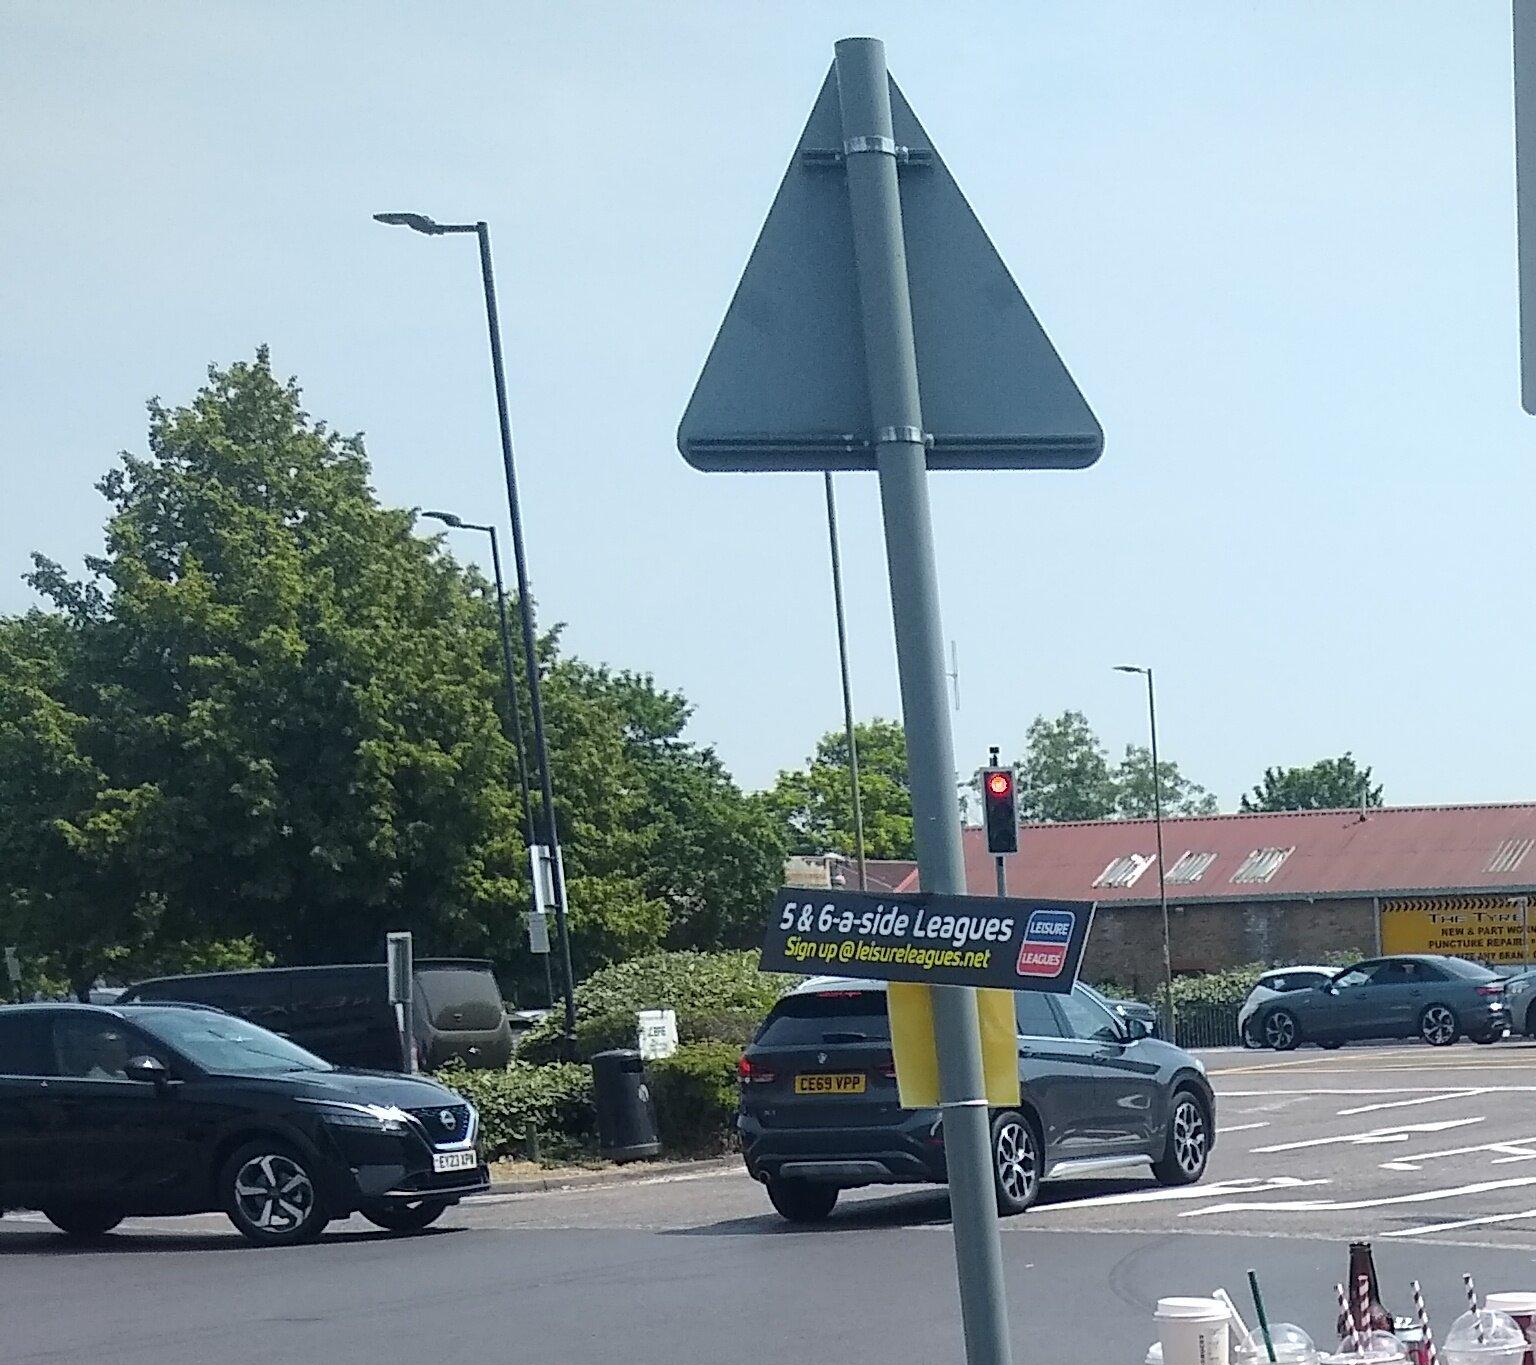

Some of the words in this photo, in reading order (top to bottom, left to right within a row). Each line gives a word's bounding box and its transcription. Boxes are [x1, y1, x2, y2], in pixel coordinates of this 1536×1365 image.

[780, 903, 798, 930] 5
[798, 904, 813, 931] &
[818, 904, 909, 937] 6-a-side
[913, 909, 1014, 947] Leagues
[1029, 920, 1069, 937] LEISURE
[1441, 928, 1464, 936] NEW
[1478, 926, 1504, 935] PART
[784, 936, 816, 960] Sign
[819, 942, 836, 963] up
[1428, 939, 1484, 949] PUNCTURE
[1486, 938, 1526, 947] REPAIR
[1021, 952, 1064, 967] LEAGUES
[1500, 951, 1524, 960] BRAN
[800, 1077, 832, 1091] CE69
[836, 1076, 860, 1090] VPP
